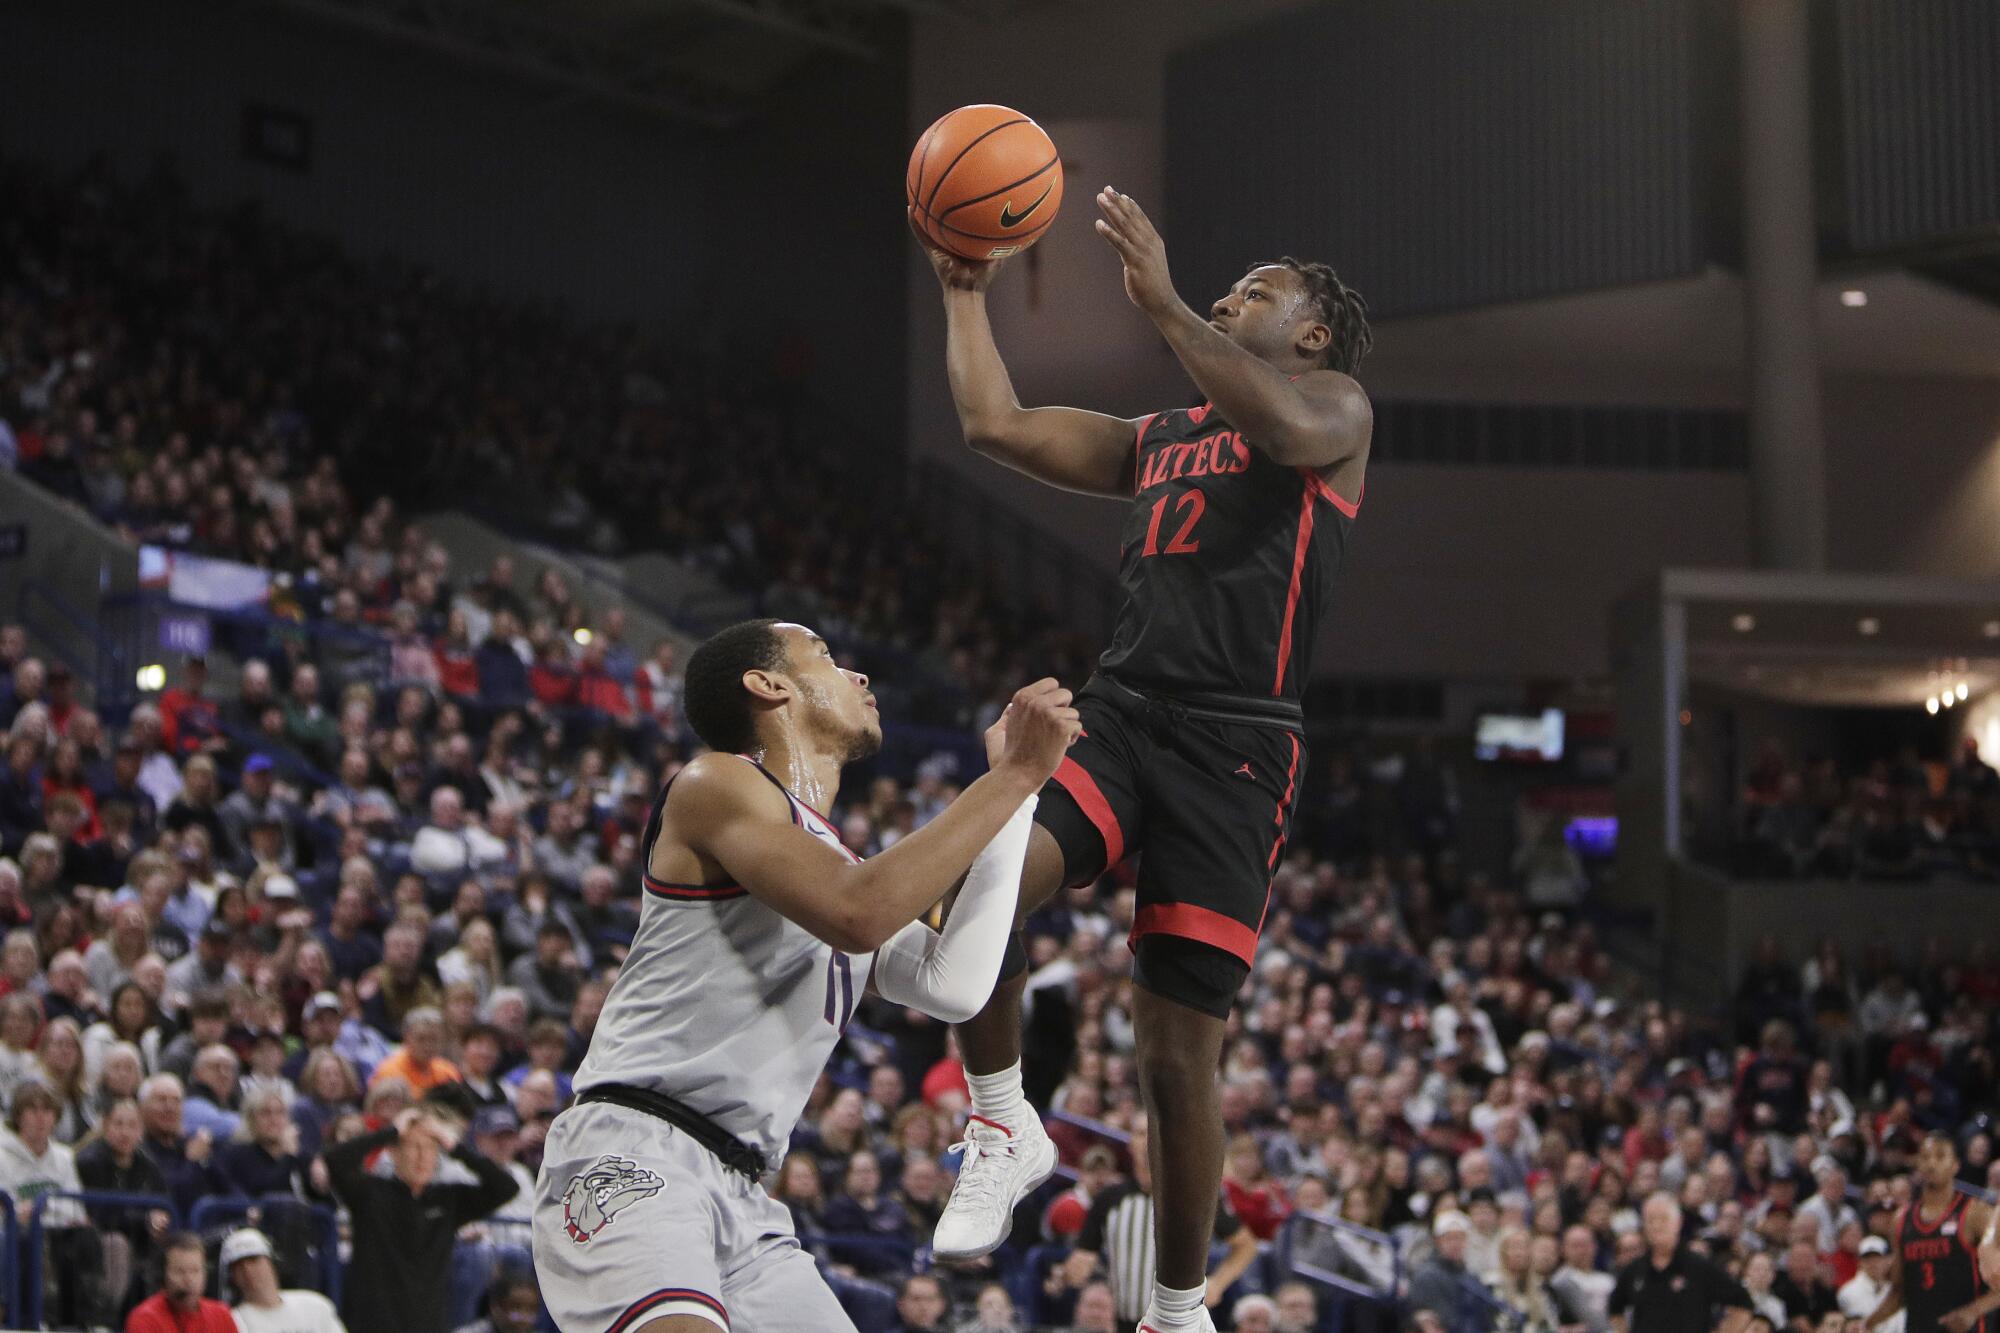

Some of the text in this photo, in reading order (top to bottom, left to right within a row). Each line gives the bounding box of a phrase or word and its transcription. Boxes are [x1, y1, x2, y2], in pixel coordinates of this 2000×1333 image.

[1140, 433, 1250, 489] AZTECS
[1143, 489, 1206, 557] 12
[824, 950, 853, 1037] 11
